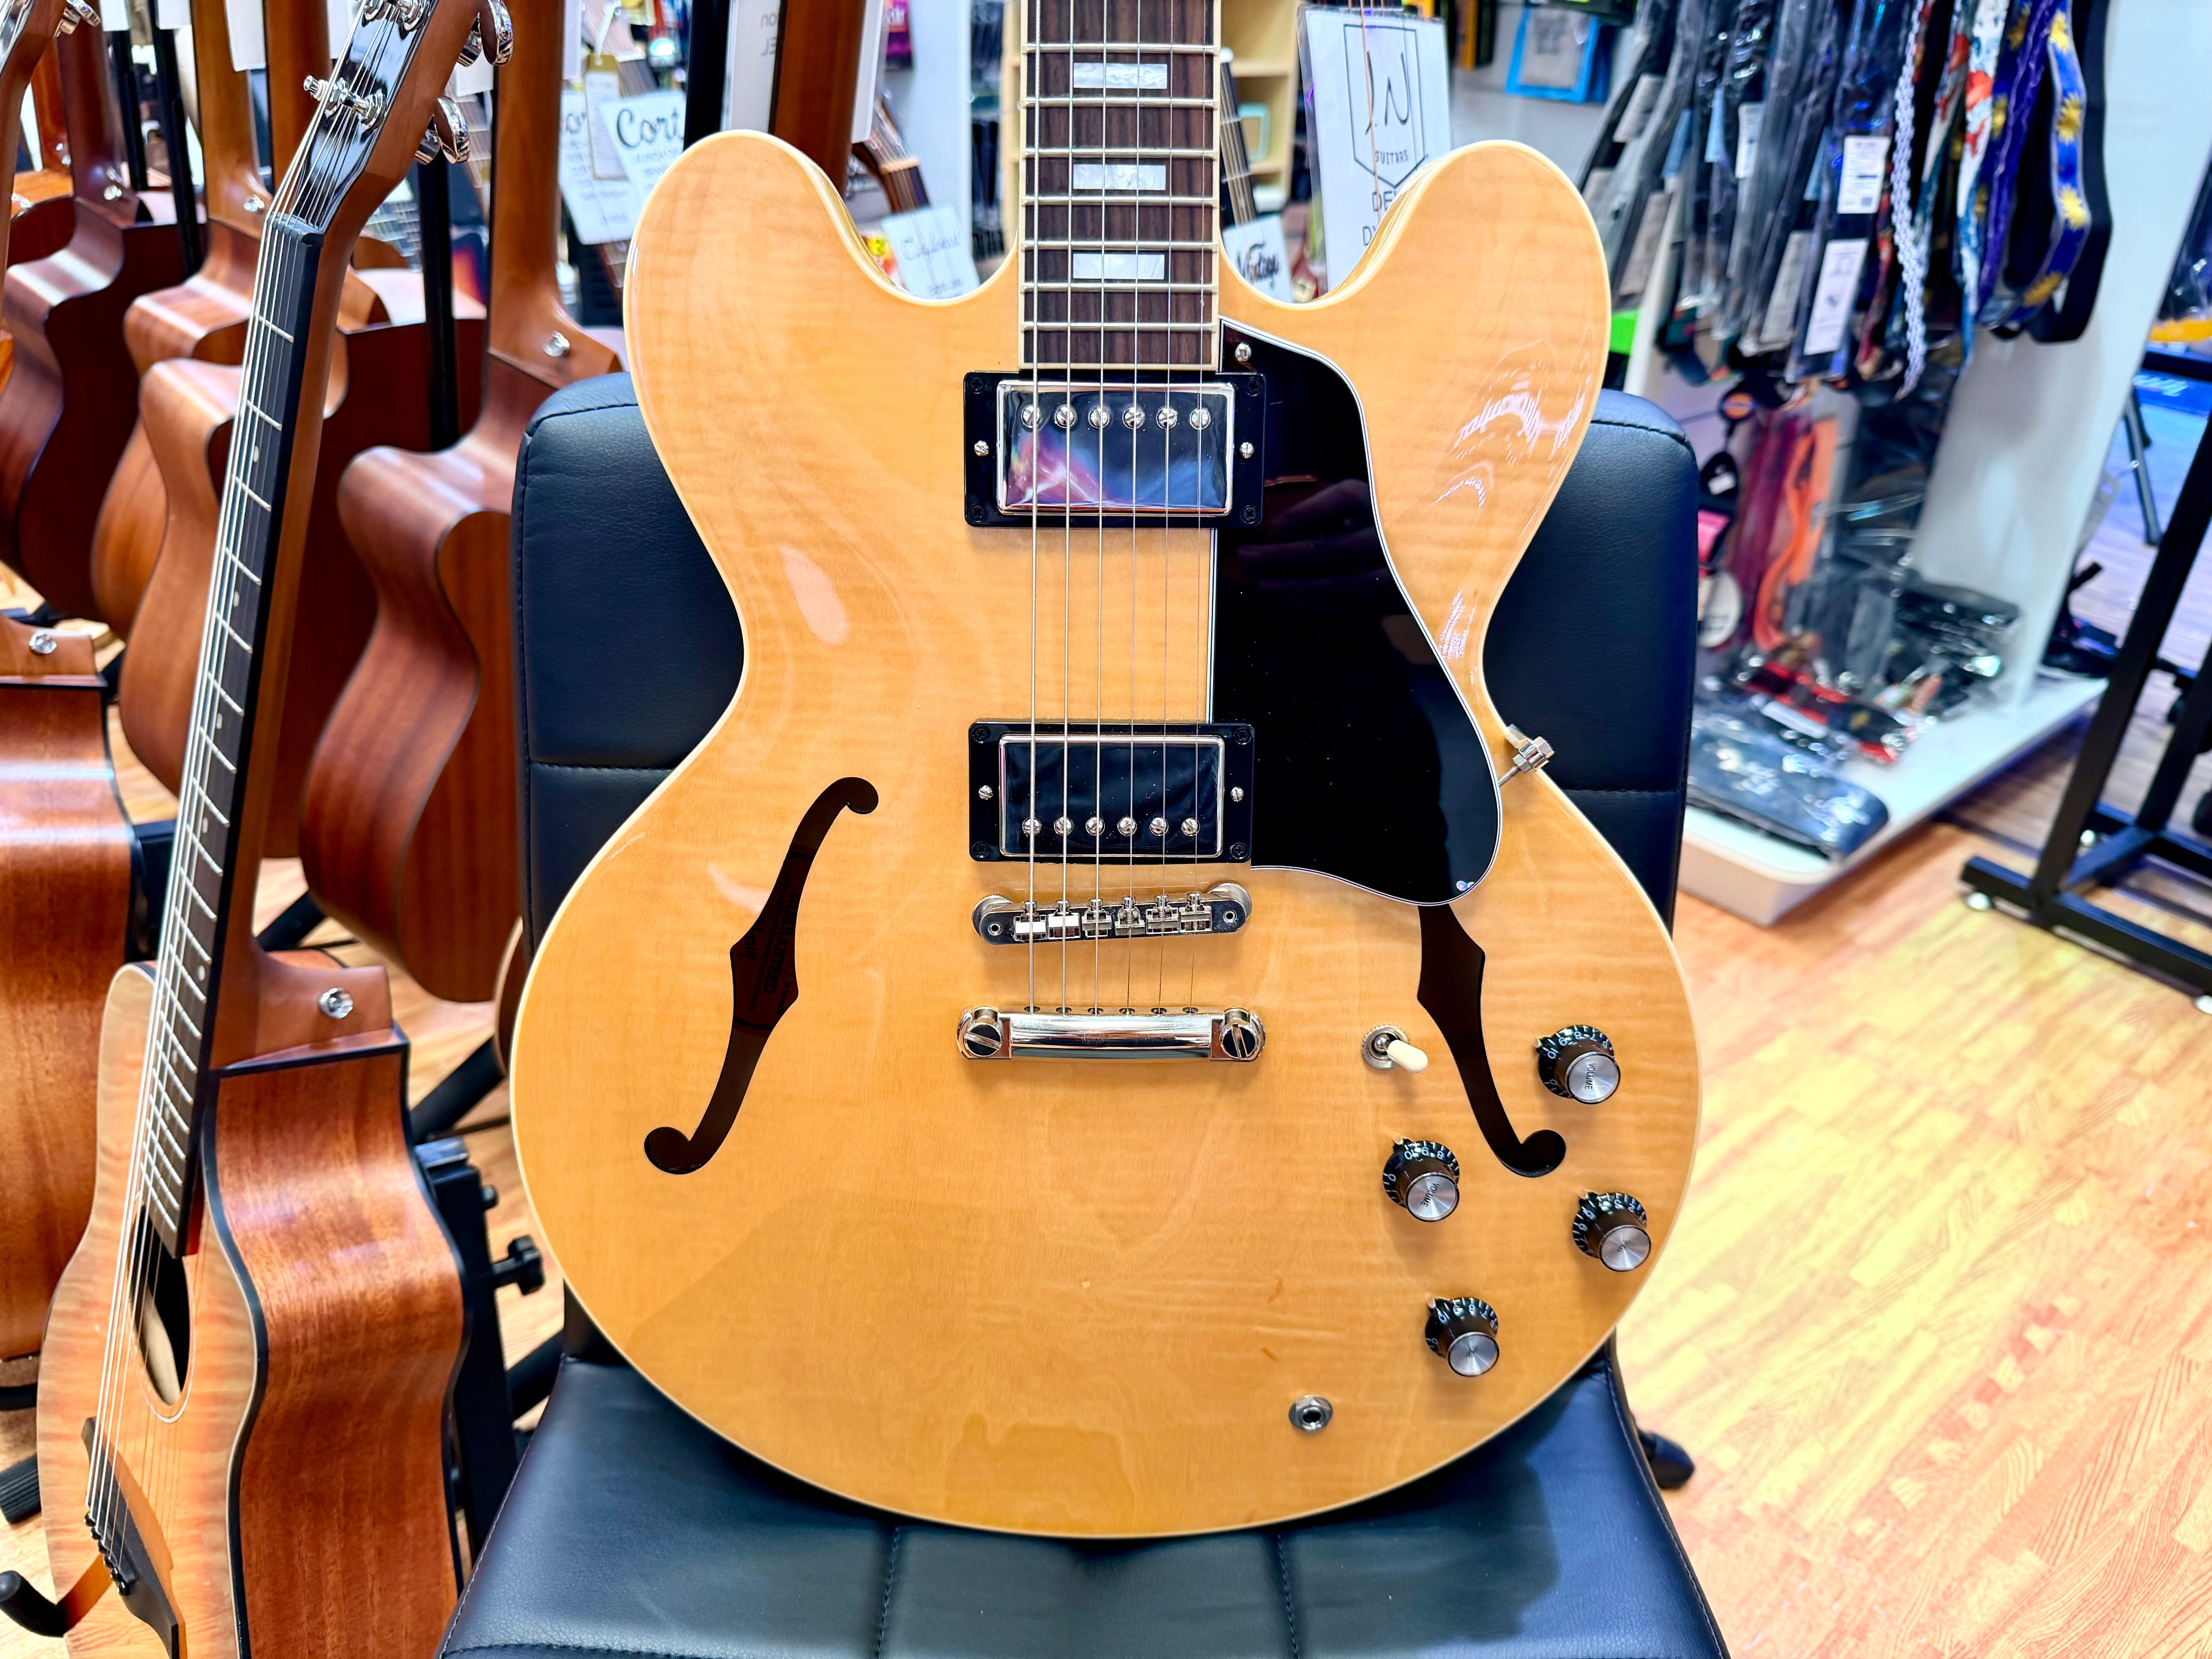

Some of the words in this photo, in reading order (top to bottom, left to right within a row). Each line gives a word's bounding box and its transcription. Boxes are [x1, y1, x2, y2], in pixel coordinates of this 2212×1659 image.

[1374, 149, 1409, 165] GUITARS
[1584, 1063, 1597, 1090] VOLUME
[1420, 1183, 1440, 1207] VOLUME
